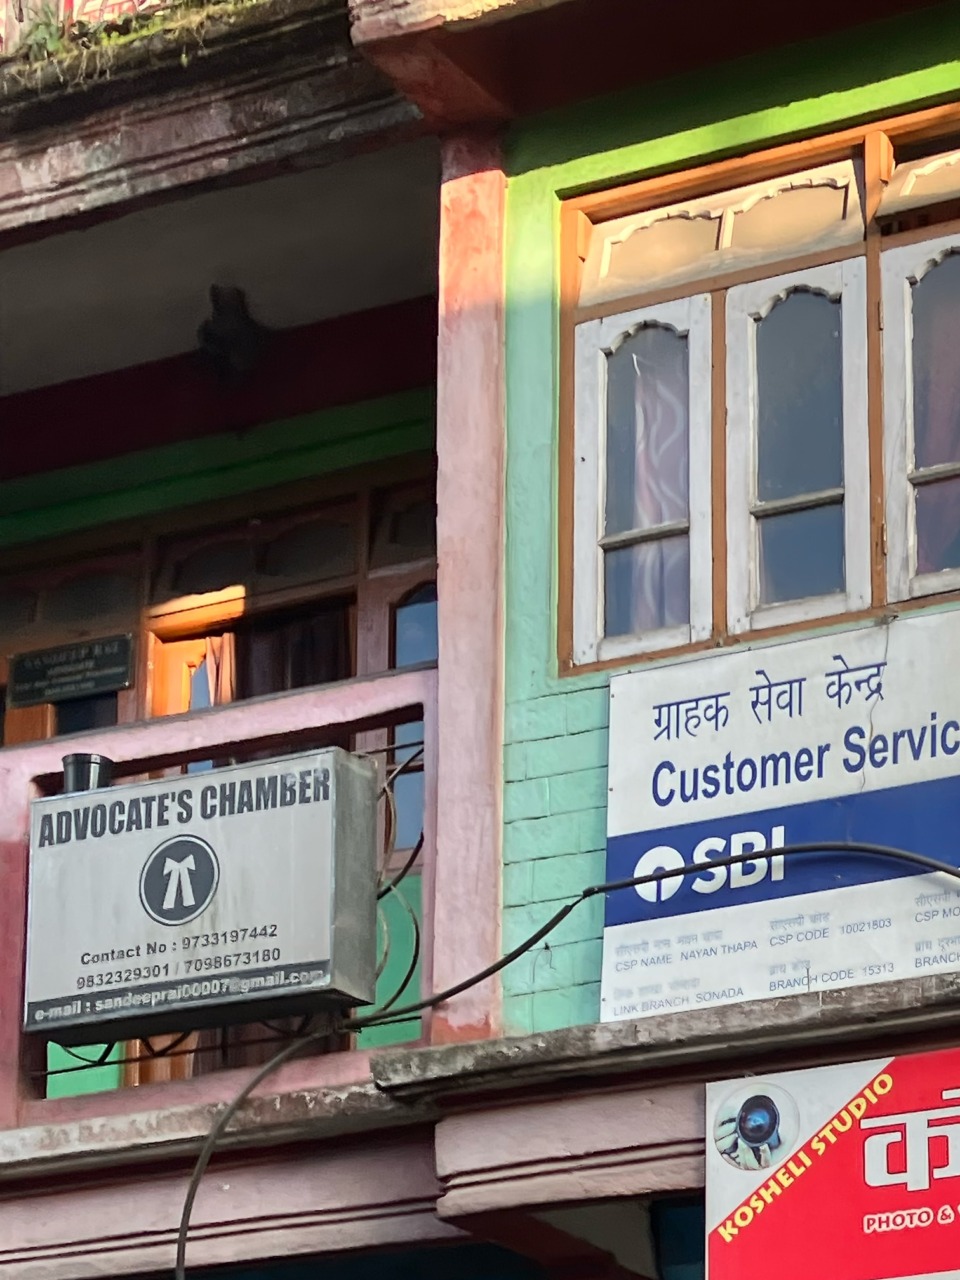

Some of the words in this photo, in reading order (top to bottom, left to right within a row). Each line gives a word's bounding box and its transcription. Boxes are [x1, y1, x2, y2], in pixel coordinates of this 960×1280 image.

[652, 691, 730, 741] ग्राहक
[749, 669, 806, 724] सेवा
[825, 655, 887, 708] केन्द्र
[652, 742, 831, 807] Customer
[38, 789, 193, 848] ADVOCATE'S
[200, 768, 330, 818] CHAMBER
[691, 825, 785, 894] SBI
[915, 910, 939, 923] CSP
[81, 945, 141, 965] Contact
[146, 941, 166, 955] No
[182, 924, 278, 949] 9733197442
[769, 933, 793, 947] CSP
[797, 928, 829, 942] CODE
[615, 960, 637, 972] CSP
[641, 954, 672, 967] NAME
[680, 946, 718, 961] NAYAN
[722, 940, 758, 953] THAPA
[769, 975, 818, 991] BRANCH
[821, 969, 854, 983] CODE
[34, 1000, 82, 1020] e-mail
[613, 1004, 638, 1016] LINK
[641, 996, 689, 1011] BRANCH
[696, 987, 743, 1003] SONADA
[717, 1152, 811, 1243] KOSHELI
[810, 1072, 893, 1156] STUDIO
[863, 1207, 934, 1233] PHOTO
[937, 1204, 953, 1223] &
